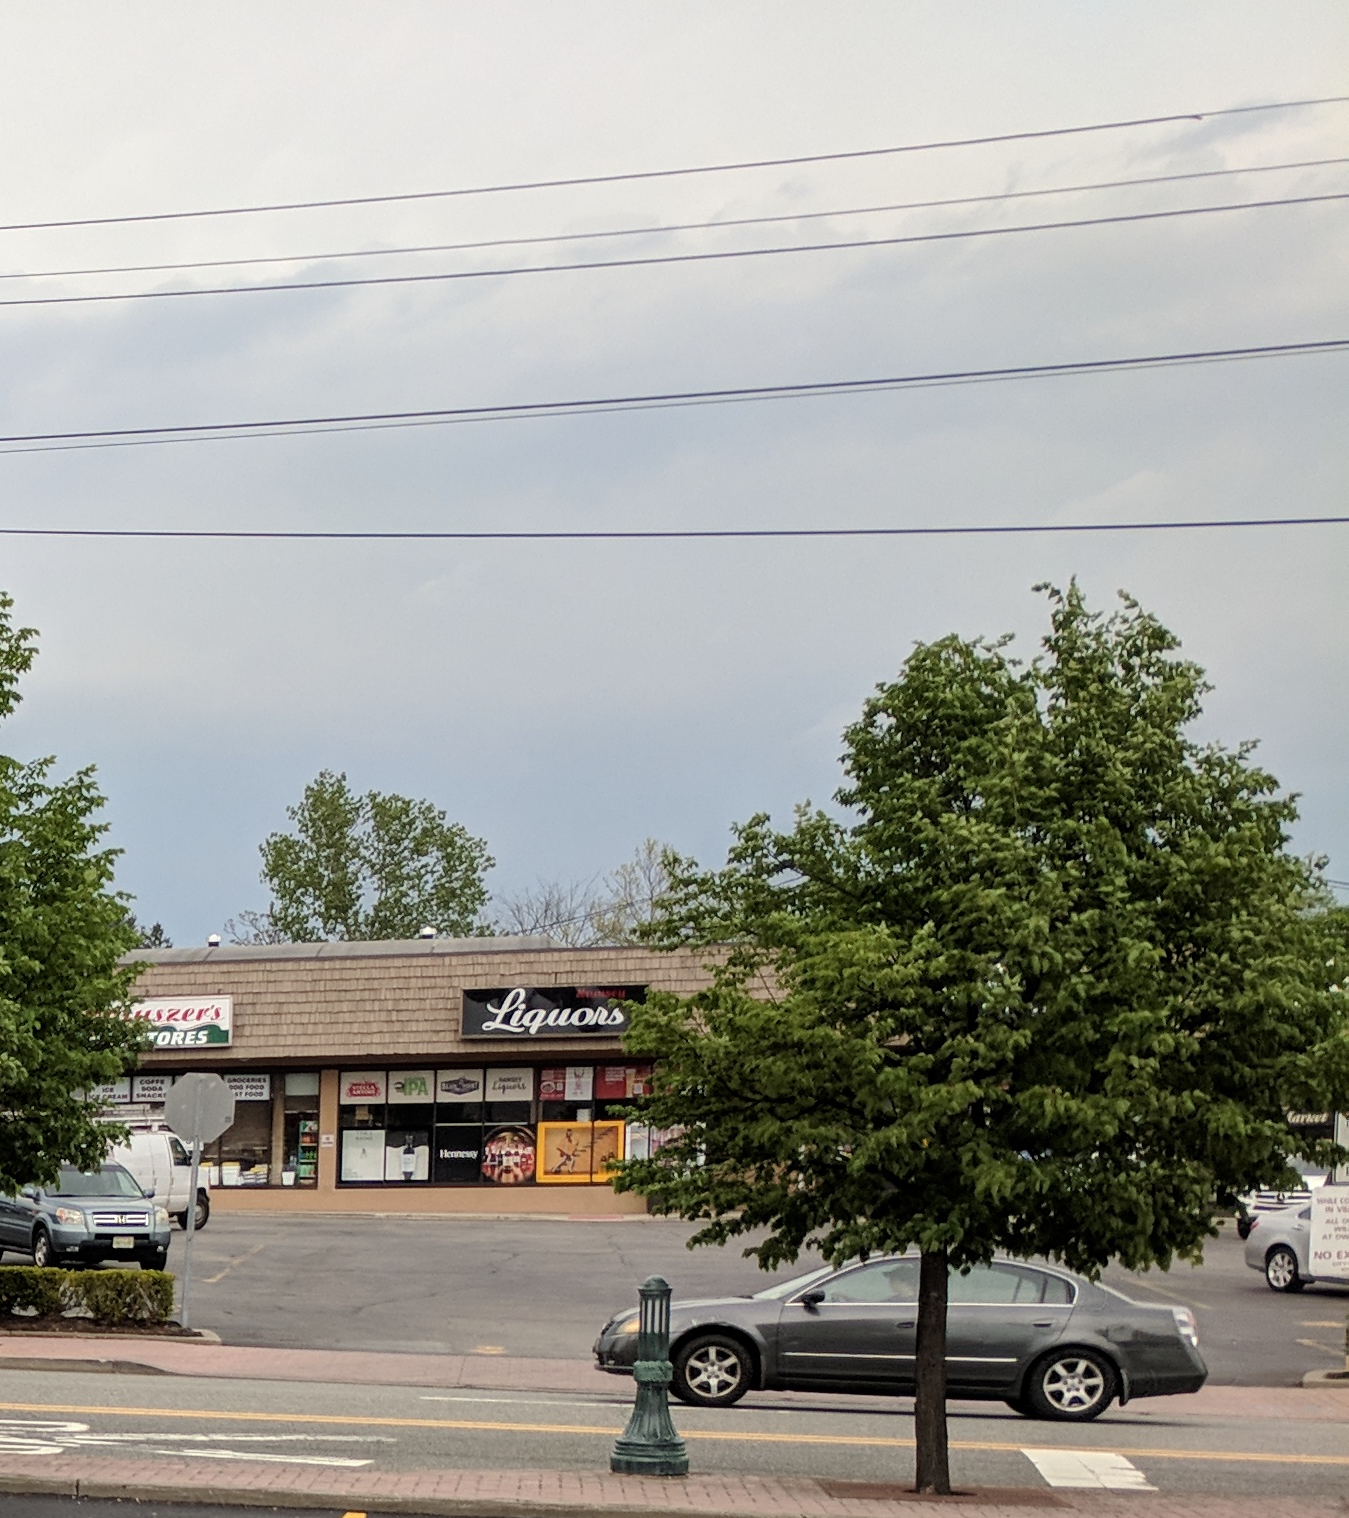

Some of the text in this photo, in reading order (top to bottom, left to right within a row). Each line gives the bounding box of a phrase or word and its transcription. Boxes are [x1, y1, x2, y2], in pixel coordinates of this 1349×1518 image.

[123, 1004, 224, 1022] uszer's
[482, 988, 624, 1034] Liquors
[146, 1030, 209, 1046] TORES
[404, 1077, 429, 1097] IPA
[491, 1080, 527, 1095] Liquors
[439, 1149, 479, 1159] Hennessy
[1314, 1250, 1332, 1260] NO
